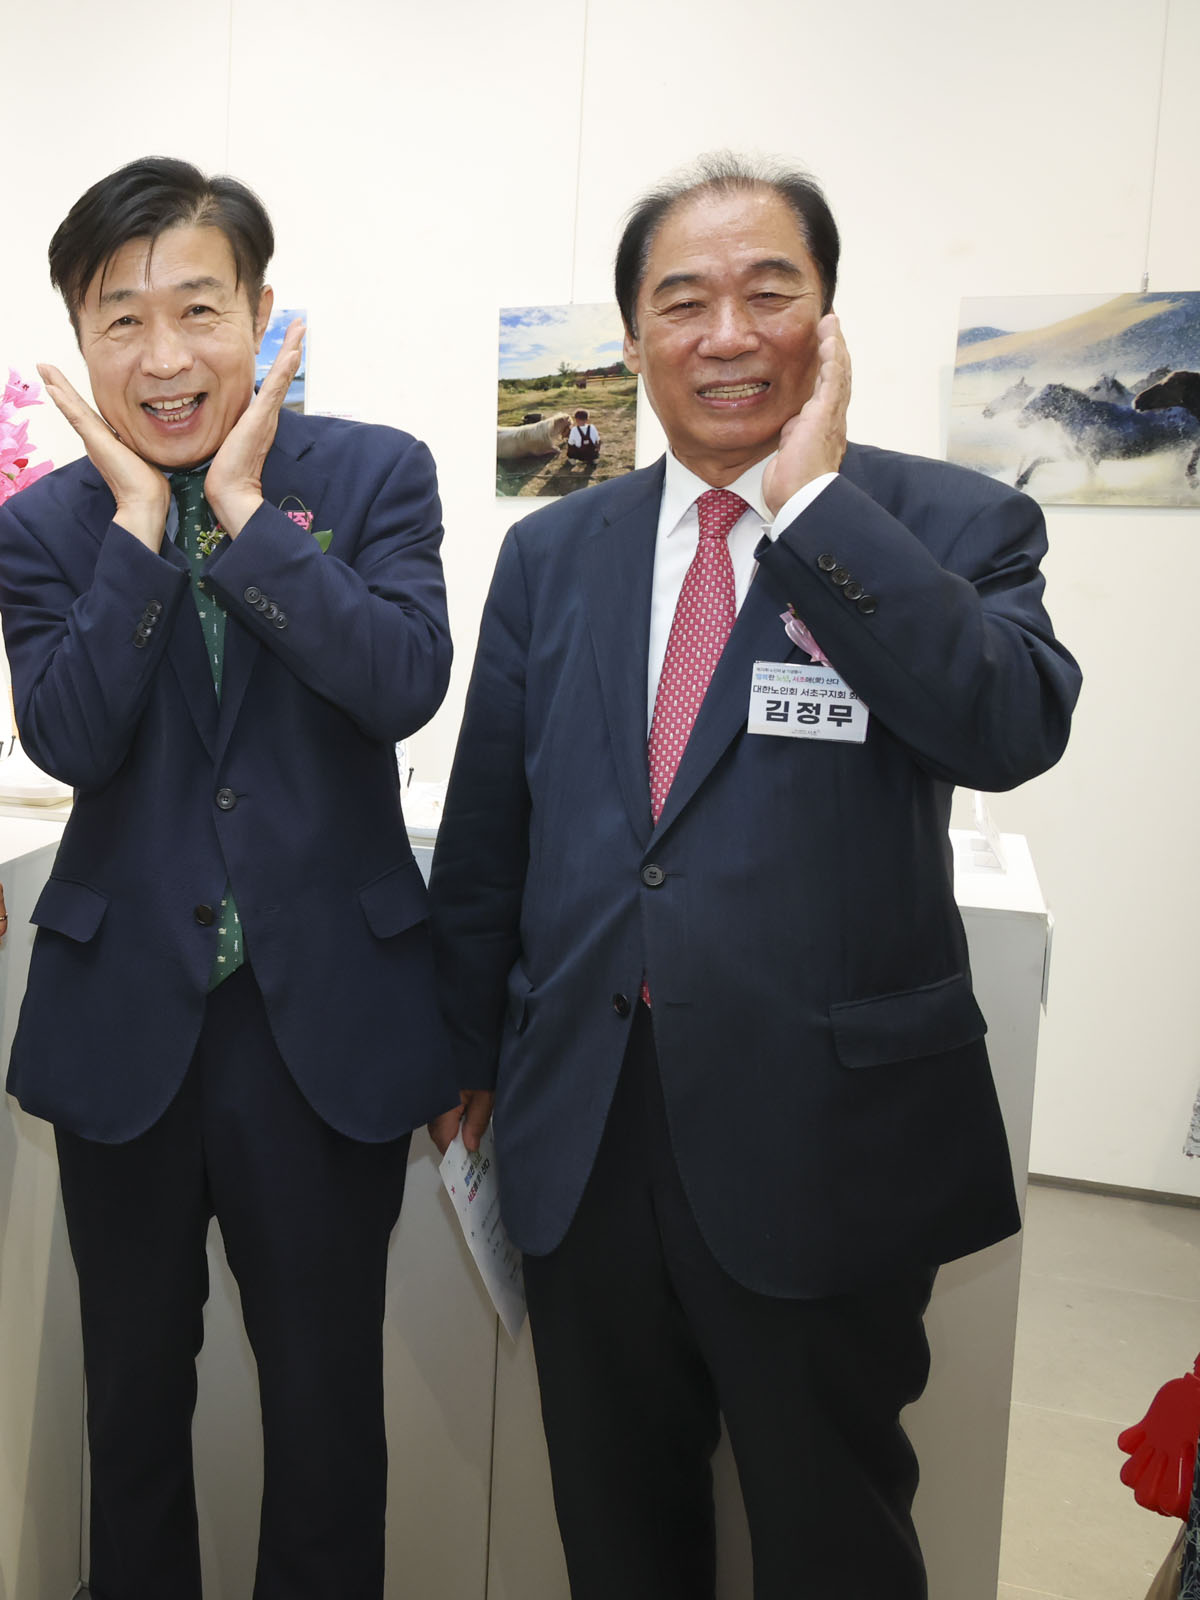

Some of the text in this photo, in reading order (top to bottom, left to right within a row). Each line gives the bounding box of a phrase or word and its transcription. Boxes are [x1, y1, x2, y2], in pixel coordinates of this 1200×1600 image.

[753, 685, 797, 696] 대한노인회
[800, 688, 846, 699] 서초구지회
[765, 699, 853, 727] 김정무
